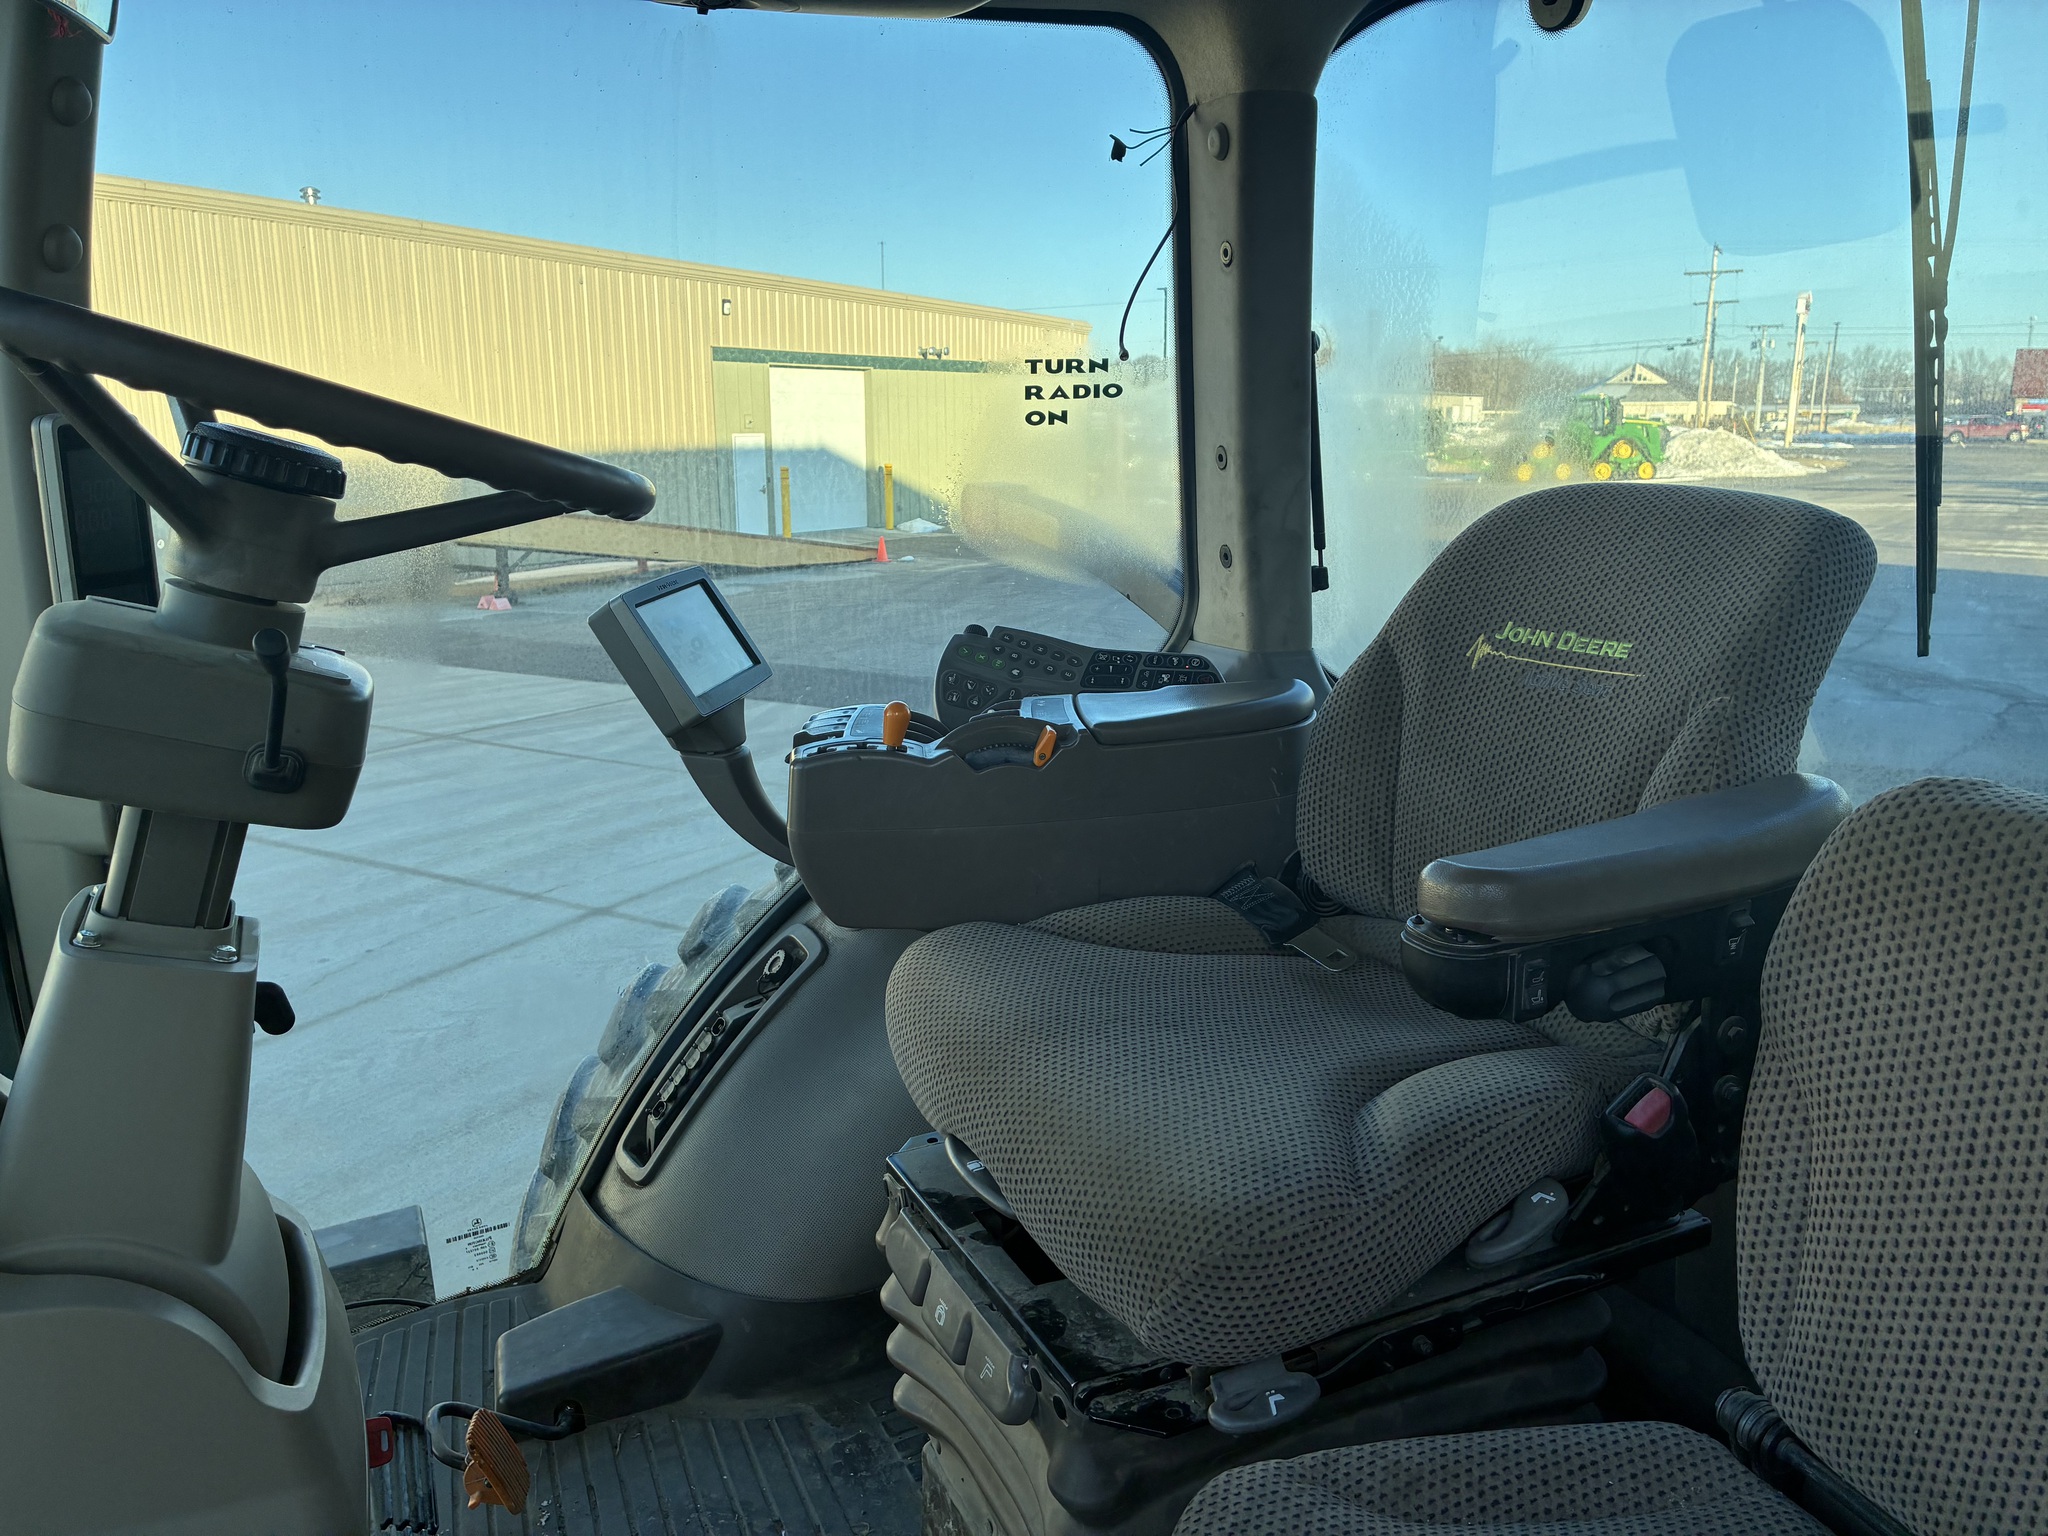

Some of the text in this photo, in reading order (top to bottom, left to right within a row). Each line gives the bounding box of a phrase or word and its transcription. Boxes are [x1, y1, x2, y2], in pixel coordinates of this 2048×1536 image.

[1025, 358, 1109, 374] TURN
[1025, 383, 1123, 400] RADIO
[1025, 410, 1068, 426] ON
[1495, 621, 1633, 659] JOHN DEERE
